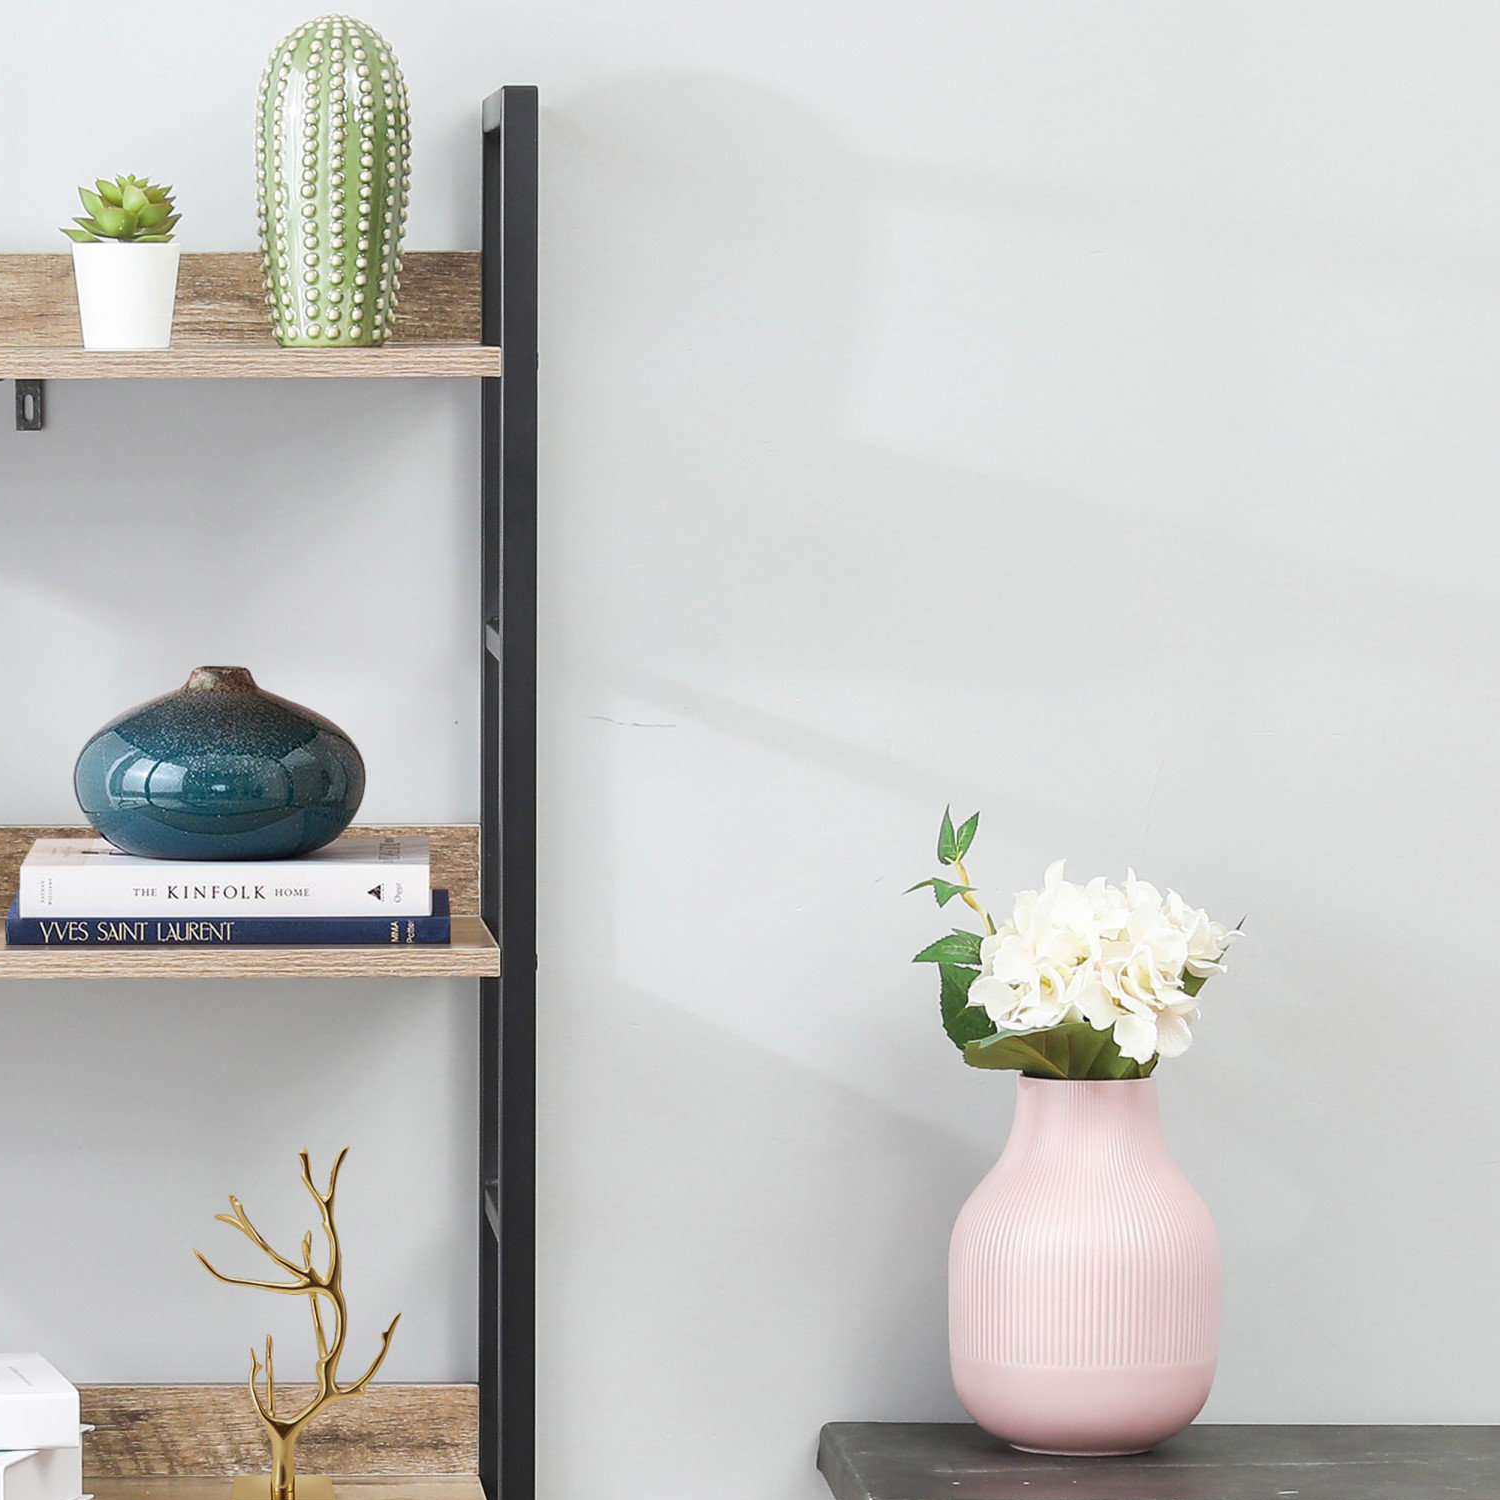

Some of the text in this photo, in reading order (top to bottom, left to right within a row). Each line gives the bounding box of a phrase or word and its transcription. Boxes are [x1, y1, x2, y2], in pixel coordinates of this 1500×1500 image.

[133, 885, 311, 899] THE KINFOLK HOME
[40, 922, 235, 943] YVES SAINT LAURENT
